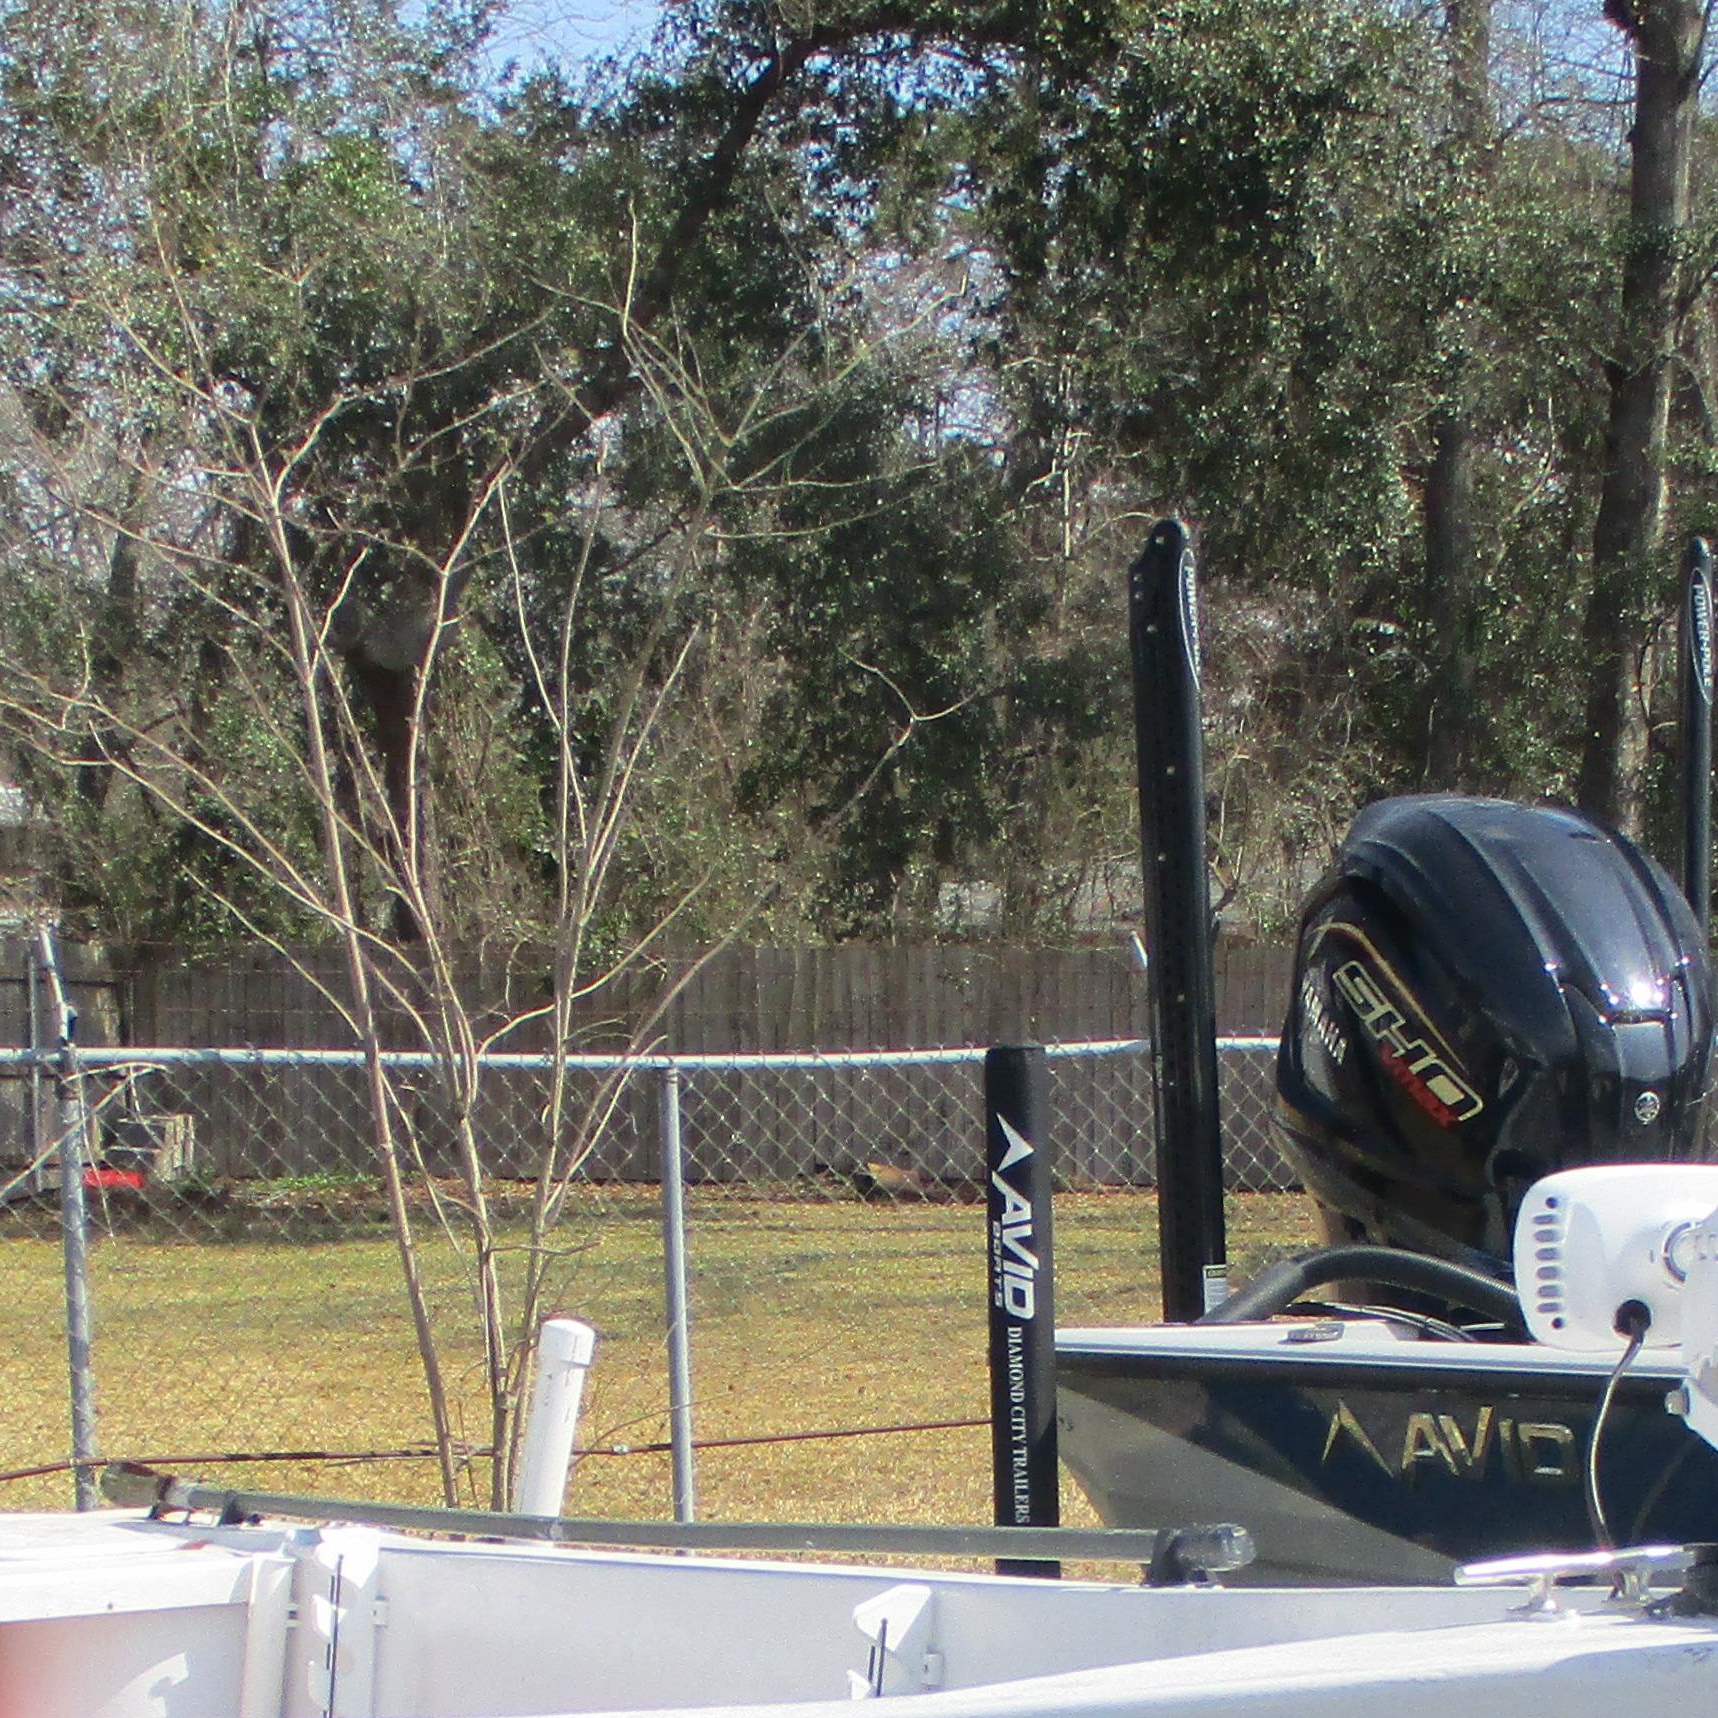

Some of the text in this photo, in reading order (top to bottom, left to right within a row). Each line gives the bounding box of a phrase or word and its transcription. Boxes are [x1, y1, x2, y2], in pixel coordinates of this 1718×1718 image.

[1332, 960, 1484, 1123] SHO
[991, 1170, 1040, 1320] AVID
[992, 1220, 1003, 1309] BOATS
[1007, 1326, 1031, 1524] DIAMOND CITY TRAILERS
[1400, 1403, 1580, 1481] AVID
